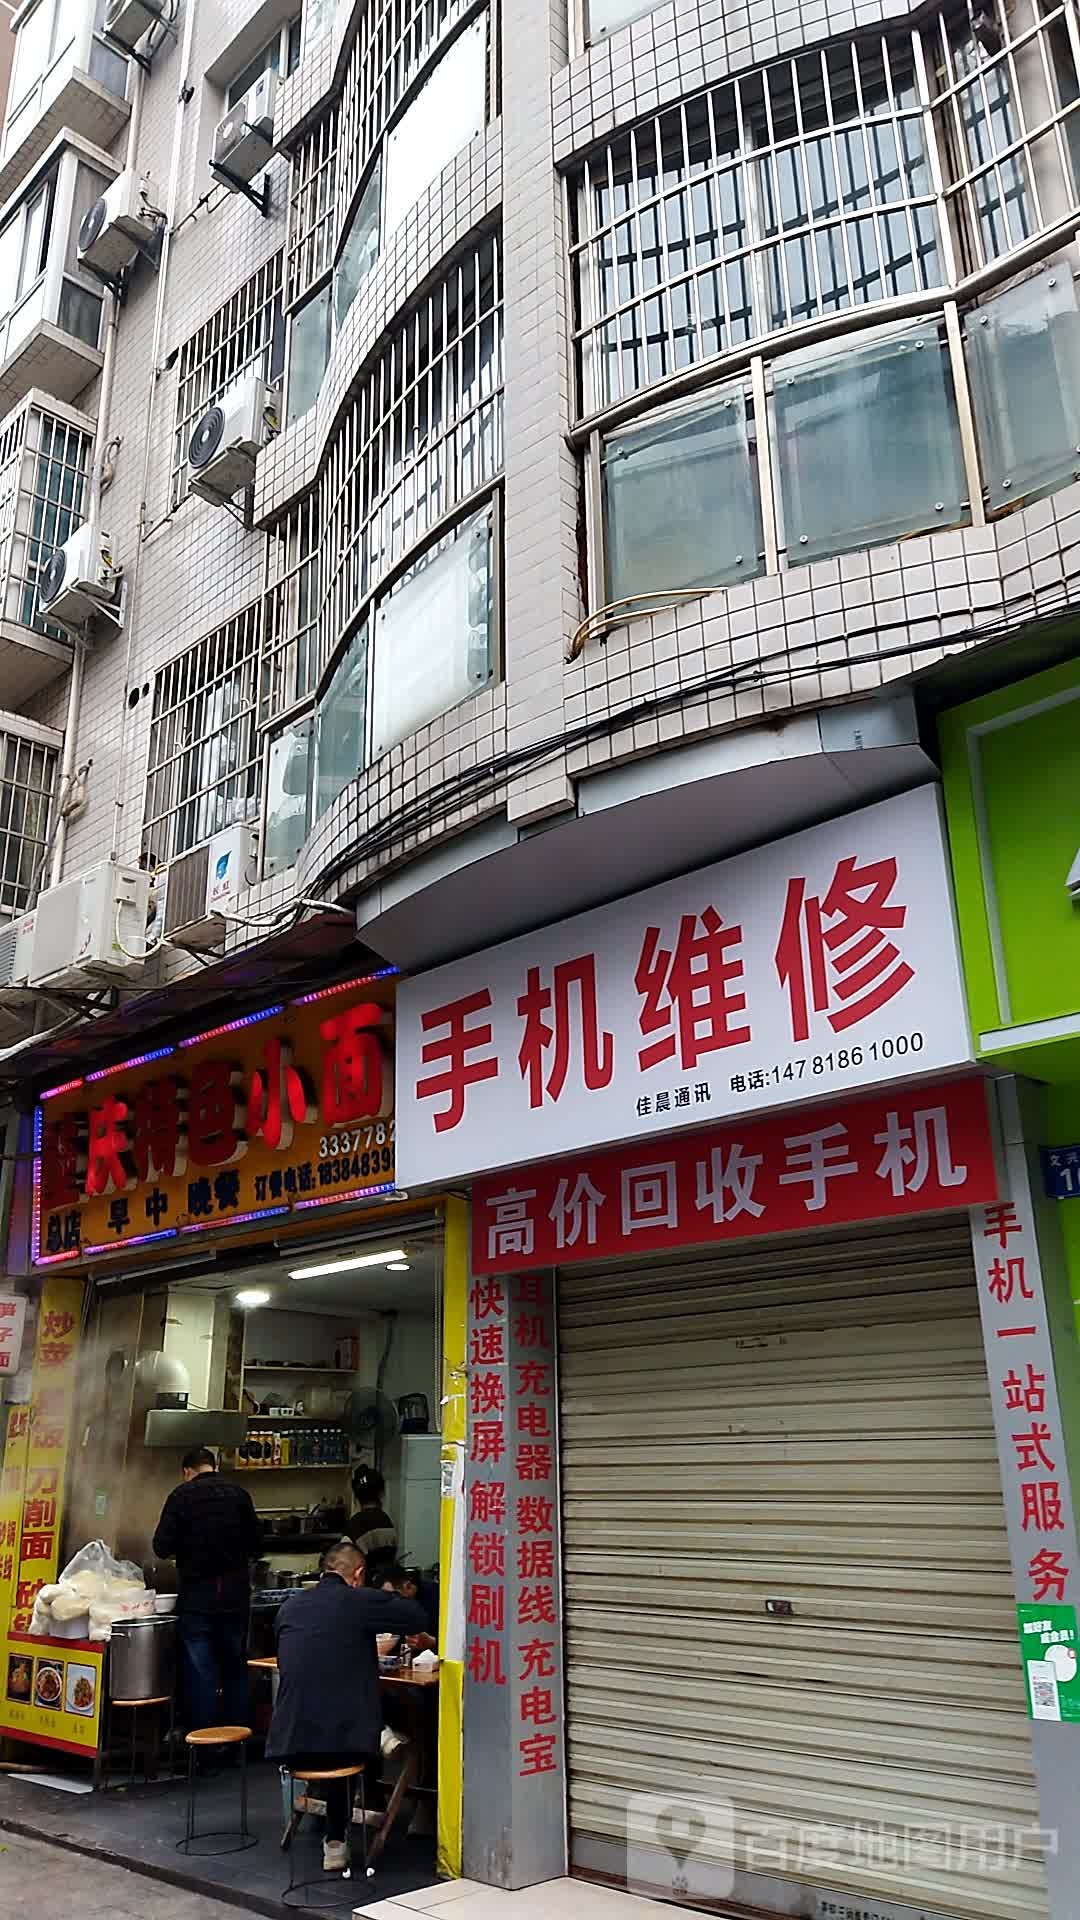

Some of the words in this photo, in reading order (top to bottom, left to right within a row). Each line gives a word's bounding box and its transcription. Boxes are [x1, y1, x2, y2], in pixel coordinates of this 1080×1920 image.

[415, 855, 915, 1133] 手机维修
[636, 1082, 711, 1117] 佳晨通讯
[485, 1105, 968, 1261] 高价回收手机
[984, 1202, 1069, 1601] 手机一站式服务
